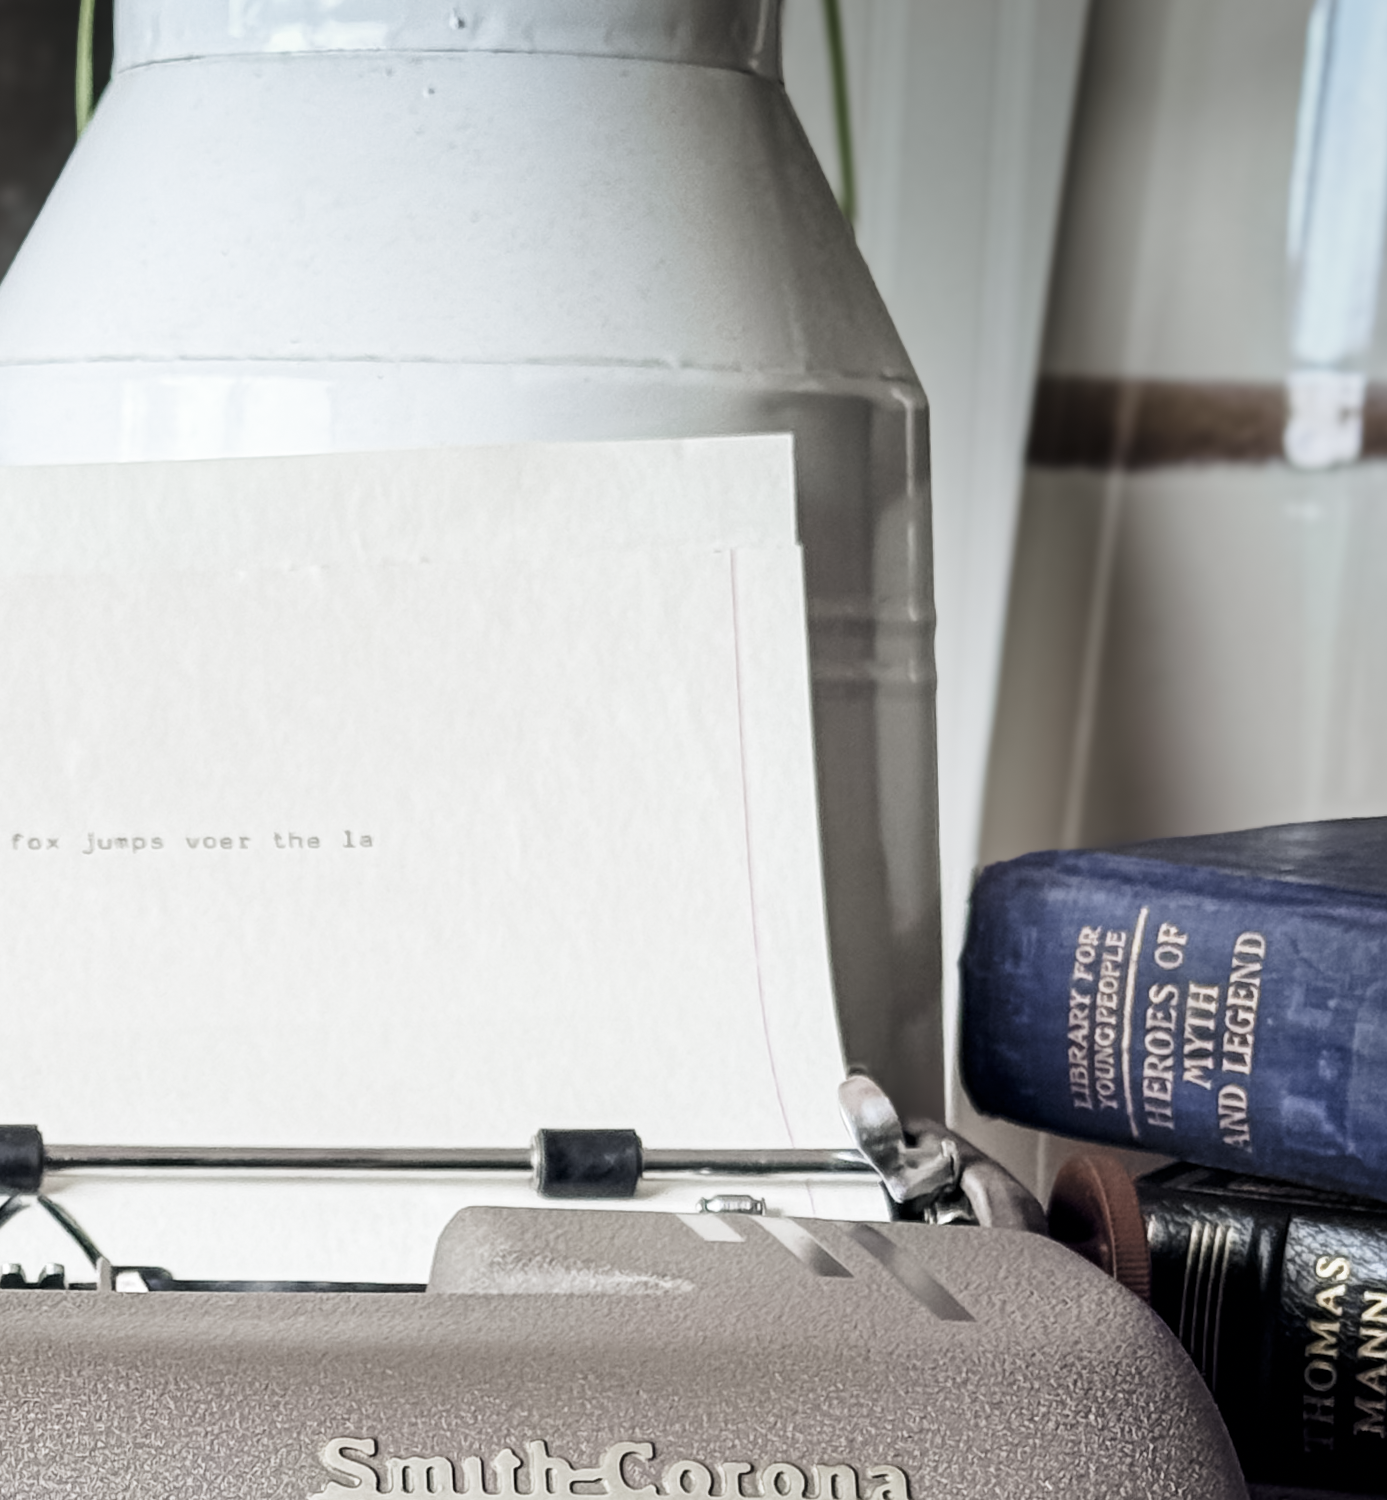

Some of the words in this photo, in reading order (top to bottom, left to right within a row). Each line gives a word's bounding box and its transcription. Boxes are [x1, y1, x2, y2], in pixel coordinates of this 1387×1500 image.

[11, 832, 60, 851] fox
[82, 832, 164, 855] jumps
[186, 834, 251, 851] voer
[273, 831, 321, 850] the
[343, 830, 374, 849] la
[1073, 925, 1102, 982] FOR
[1154, 920, 1189, 971] OF
[1067, 992, 1093, 1111] LIBRARY
[1142, 983, 1179, 1130] HEROES
[1183, 981, 1220, 1090] MYTH
[1222, 931, 1267, 1076] LEGEND
[1218, 1083, 1253, 1153] AND
[1303, 1256, 1351, 1452] THOMAS
[1354, 1290, 1387, 1439] MANN
